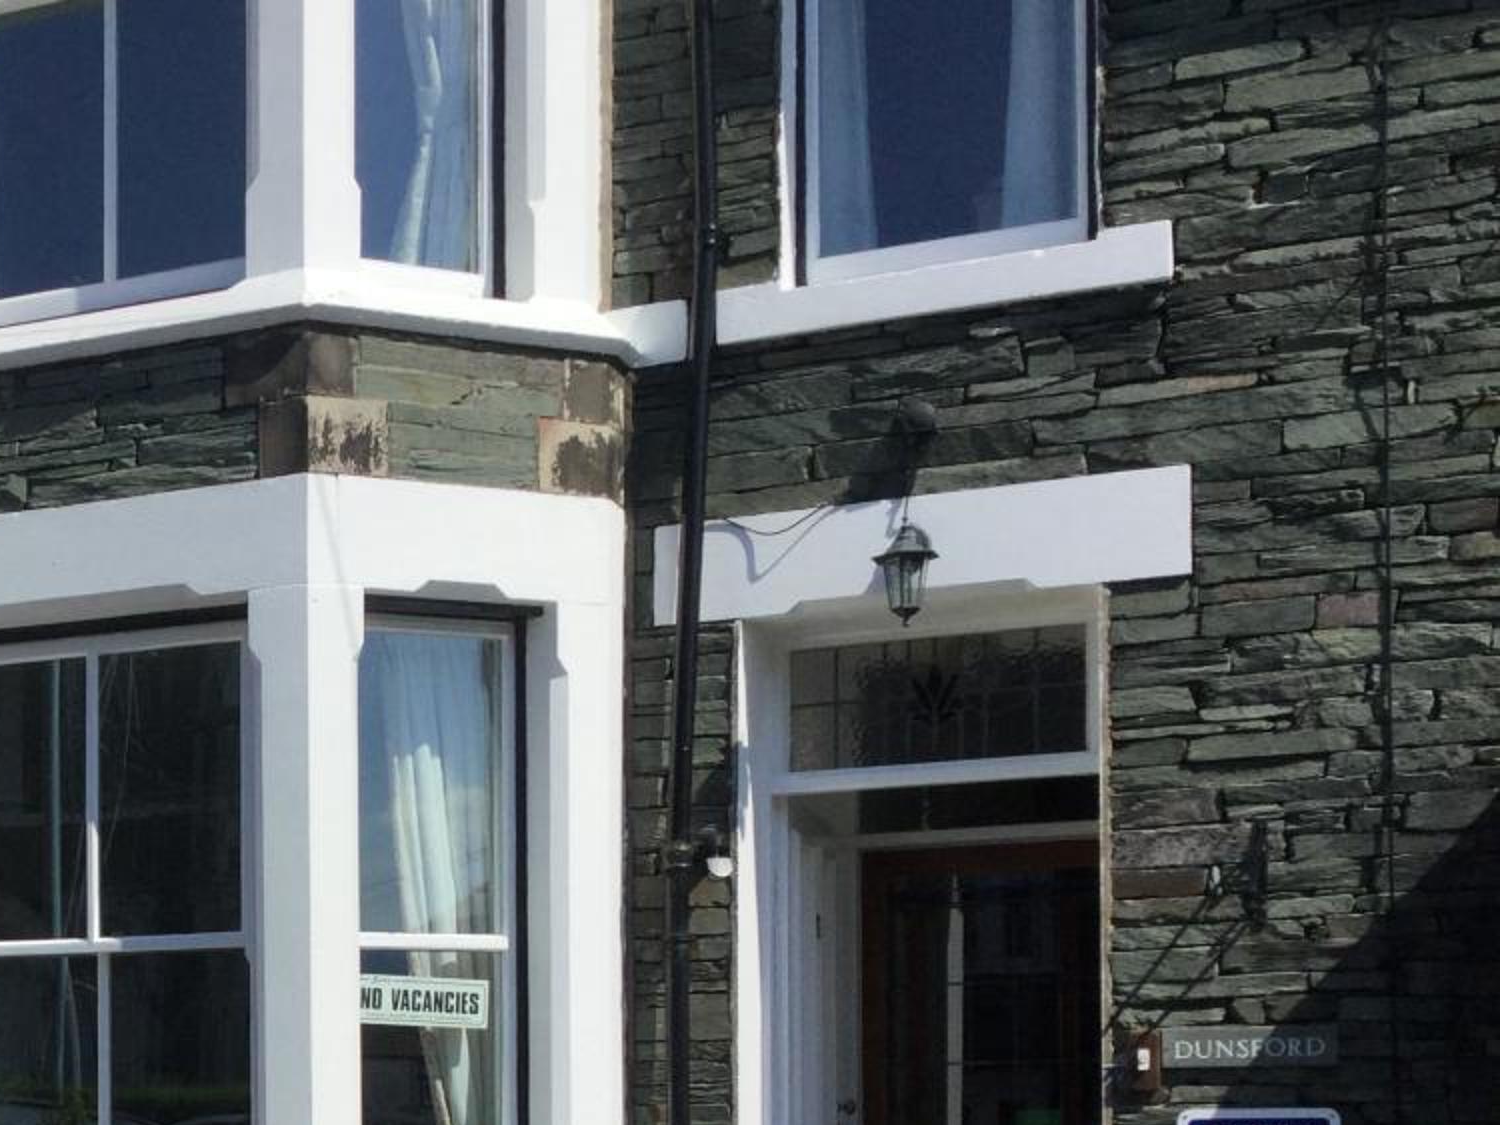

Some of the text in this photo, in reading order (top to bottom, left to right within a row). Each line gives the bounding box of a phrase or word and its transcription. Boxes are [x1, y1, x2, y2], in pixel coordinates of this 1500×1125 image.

[360, 987, 480, 1015] NO VACANCIES
[1173, 1036, 1326, 1059] DUNSFORD
